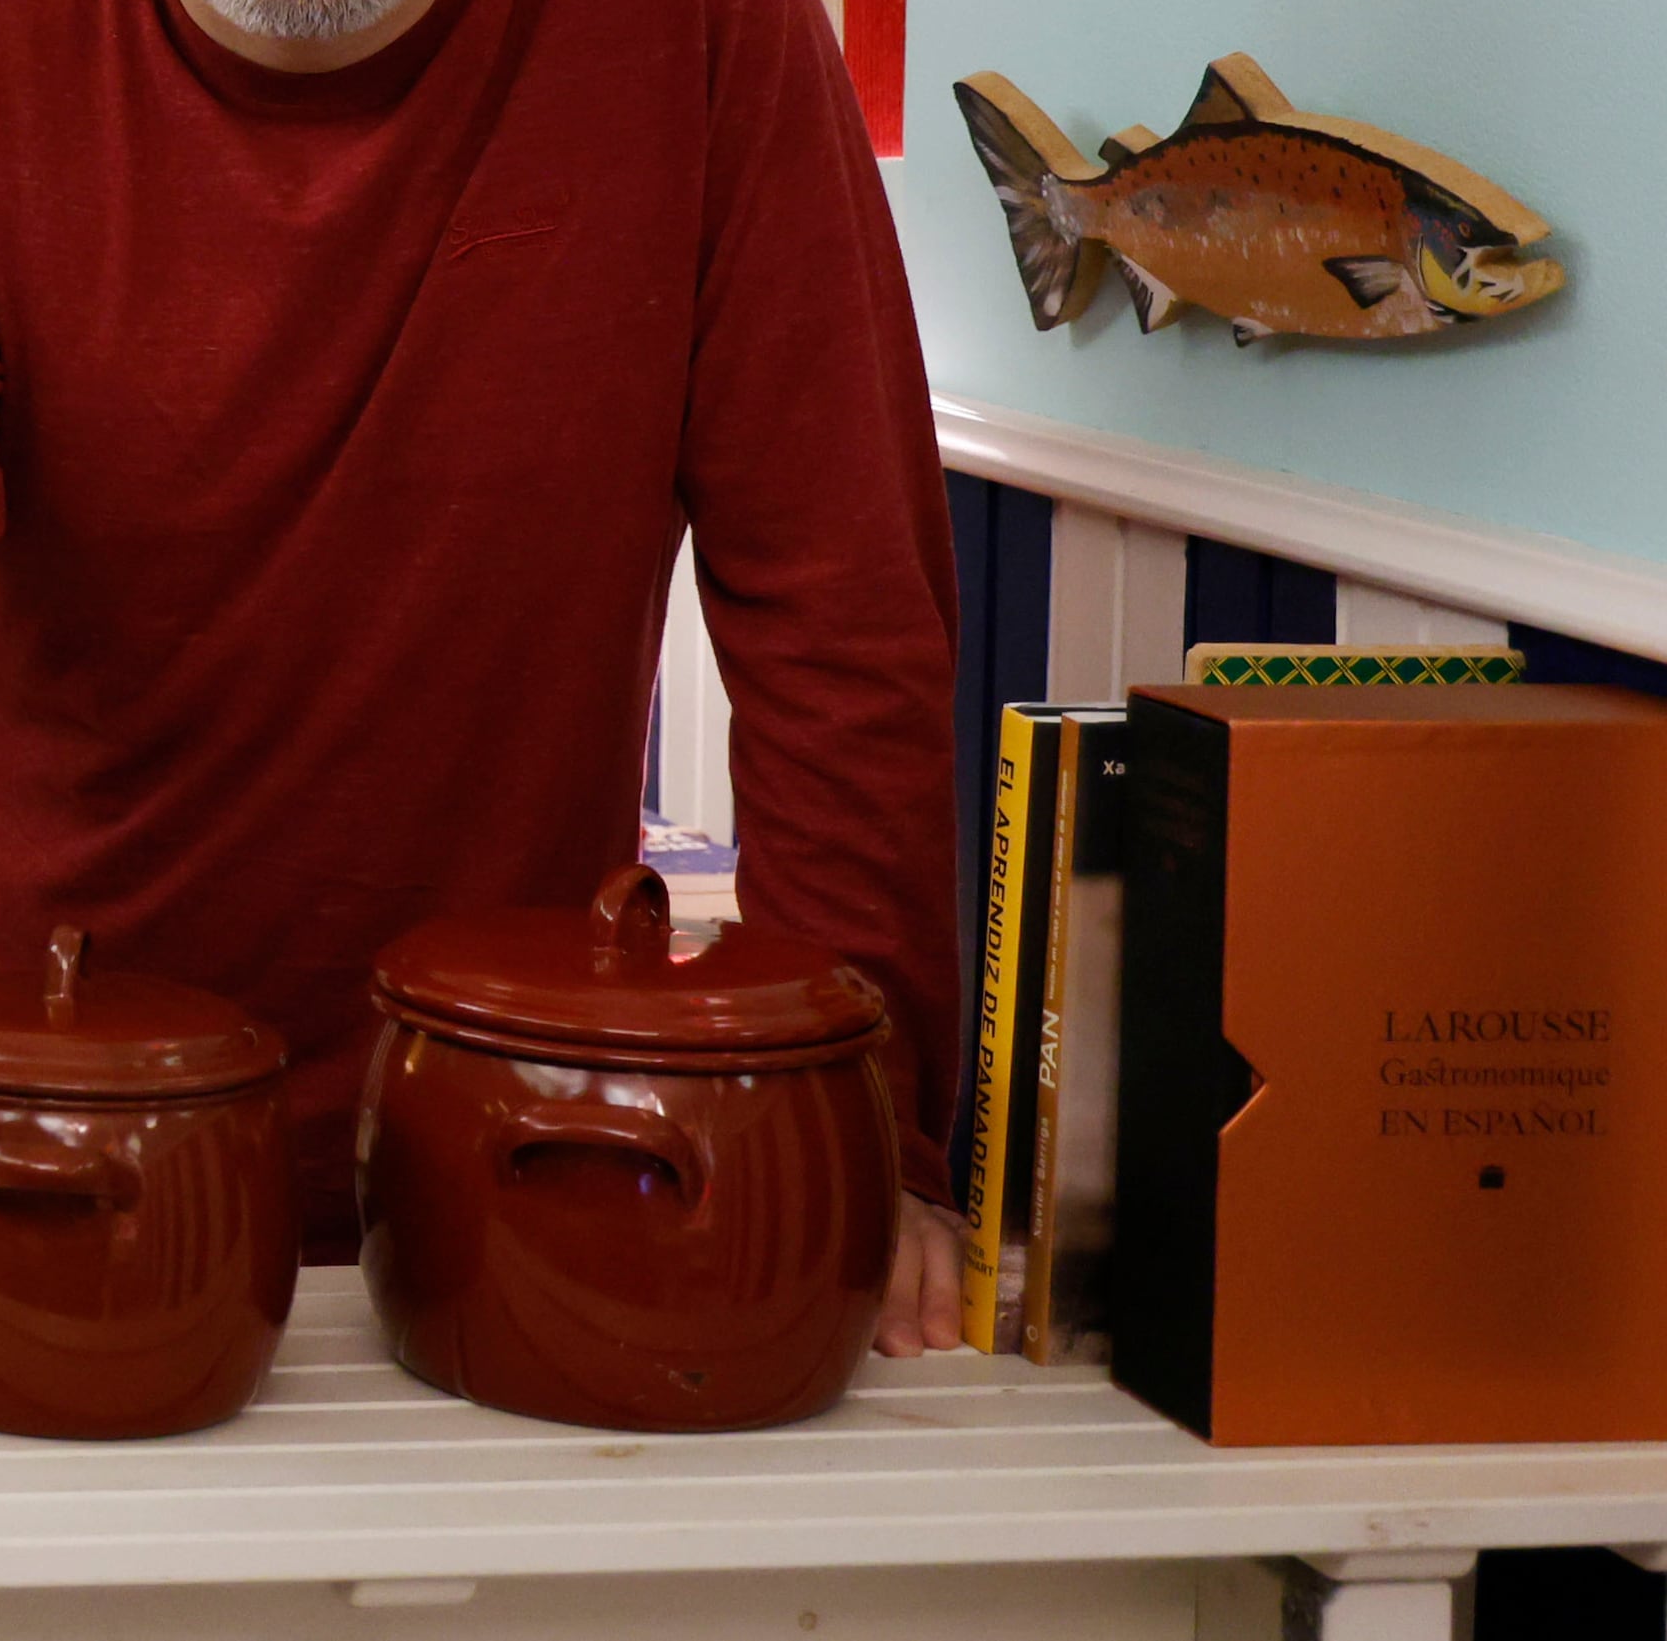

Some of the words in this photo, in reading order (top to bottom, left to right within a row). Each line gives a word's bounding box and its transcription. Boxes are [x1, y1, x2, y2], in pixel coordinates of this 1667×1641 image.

[997, 756, 1015, 797] EL
[984, 806, 1011, 985] APRENDIZ
[982, 989, 999, 1039] DE
[1381, 1010, 1612, 1043] LAROUSSE
[1038, 1008, 1060, 1089] PAN
[1379, 1058, 1613, 1098] Gastronomique
[968, 1044, 995, 1231] PANADERO
[1379, 1109, 1429, 1137] EN
[1442, 1100, 1608, 1137] ESPAÑOL
[1035, 1117, 1050, 1181] Barriga
[1033, 1187, 1045, 1239] Xavier
